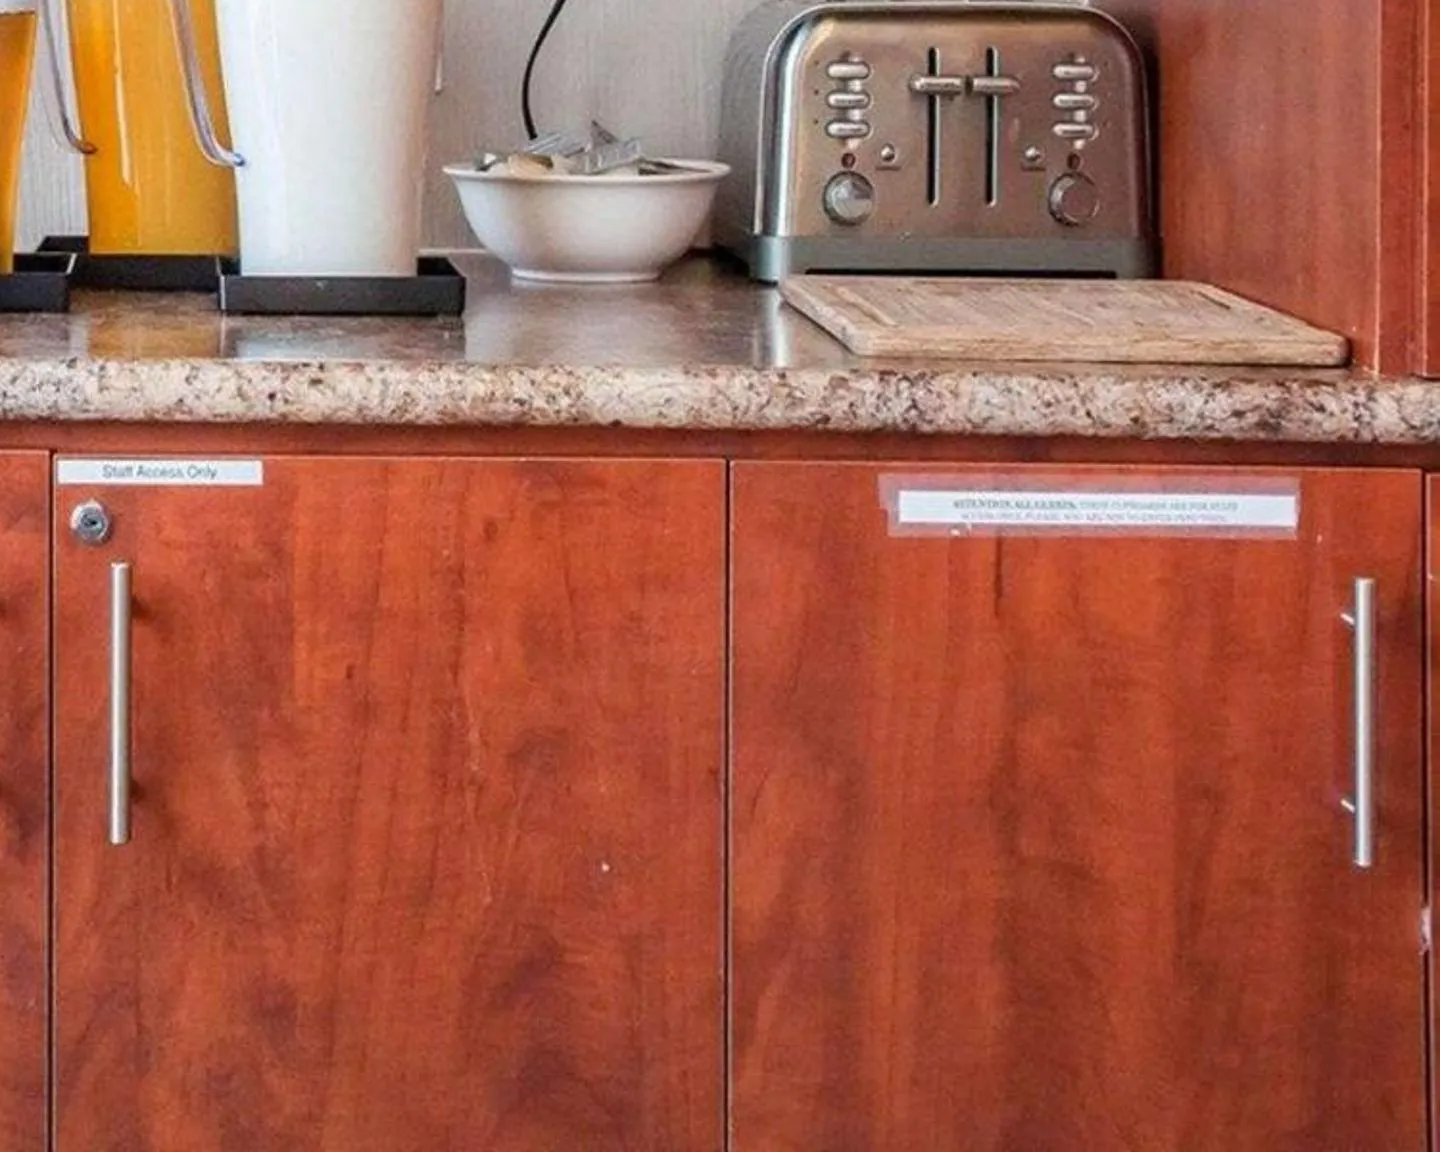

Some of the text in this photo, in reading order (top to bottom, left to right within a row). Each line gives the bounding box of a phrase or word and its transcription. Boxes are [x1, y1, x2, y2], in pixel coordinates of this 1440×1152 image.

[102, 464, 218, 480] Staff Access Only
